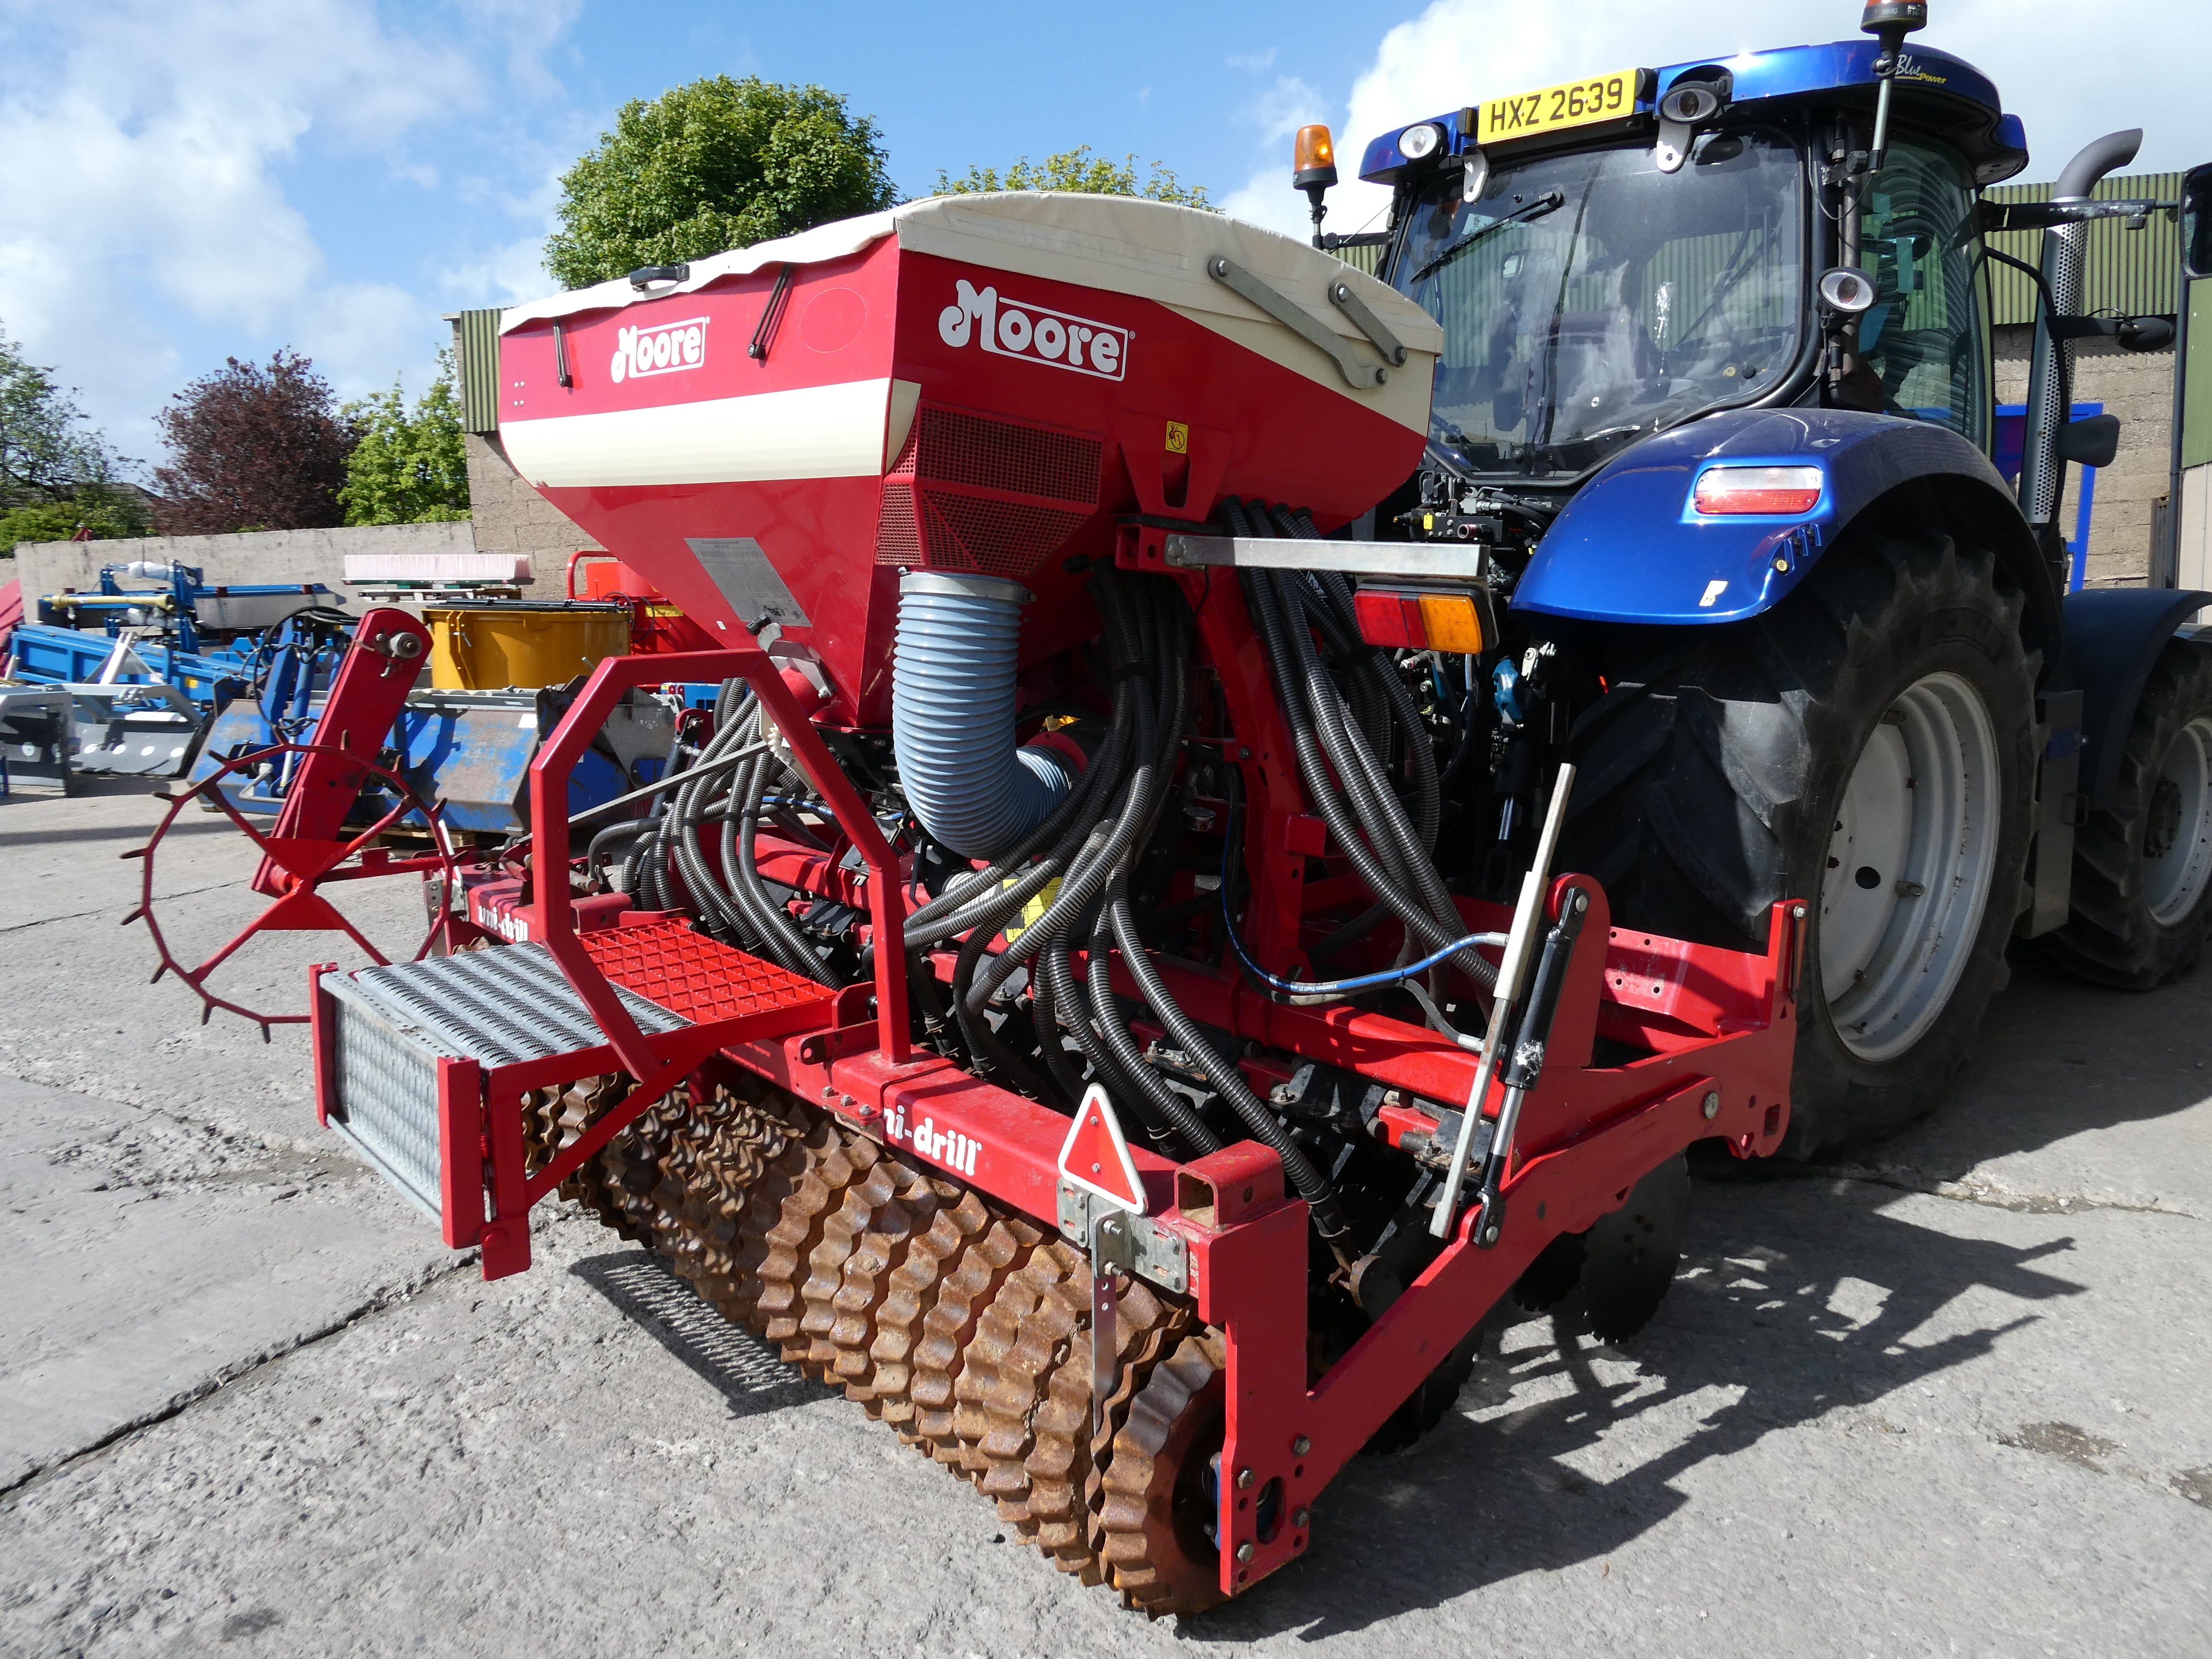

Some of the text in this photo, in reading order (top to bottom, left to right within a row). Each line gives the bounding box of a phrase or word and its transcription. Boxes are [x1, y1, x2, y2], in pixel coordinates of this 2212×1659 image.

[1895, 54, 1921, 76] Blue
[1490, 78, 1623, 133] HXZ 2639
[611, 325, 701, 383] Moore
[938, 279, 1120, 374] Moore
[478, 905, 528, 942] uni-drill
[884, 1105, 976, 1176] ni-drill
